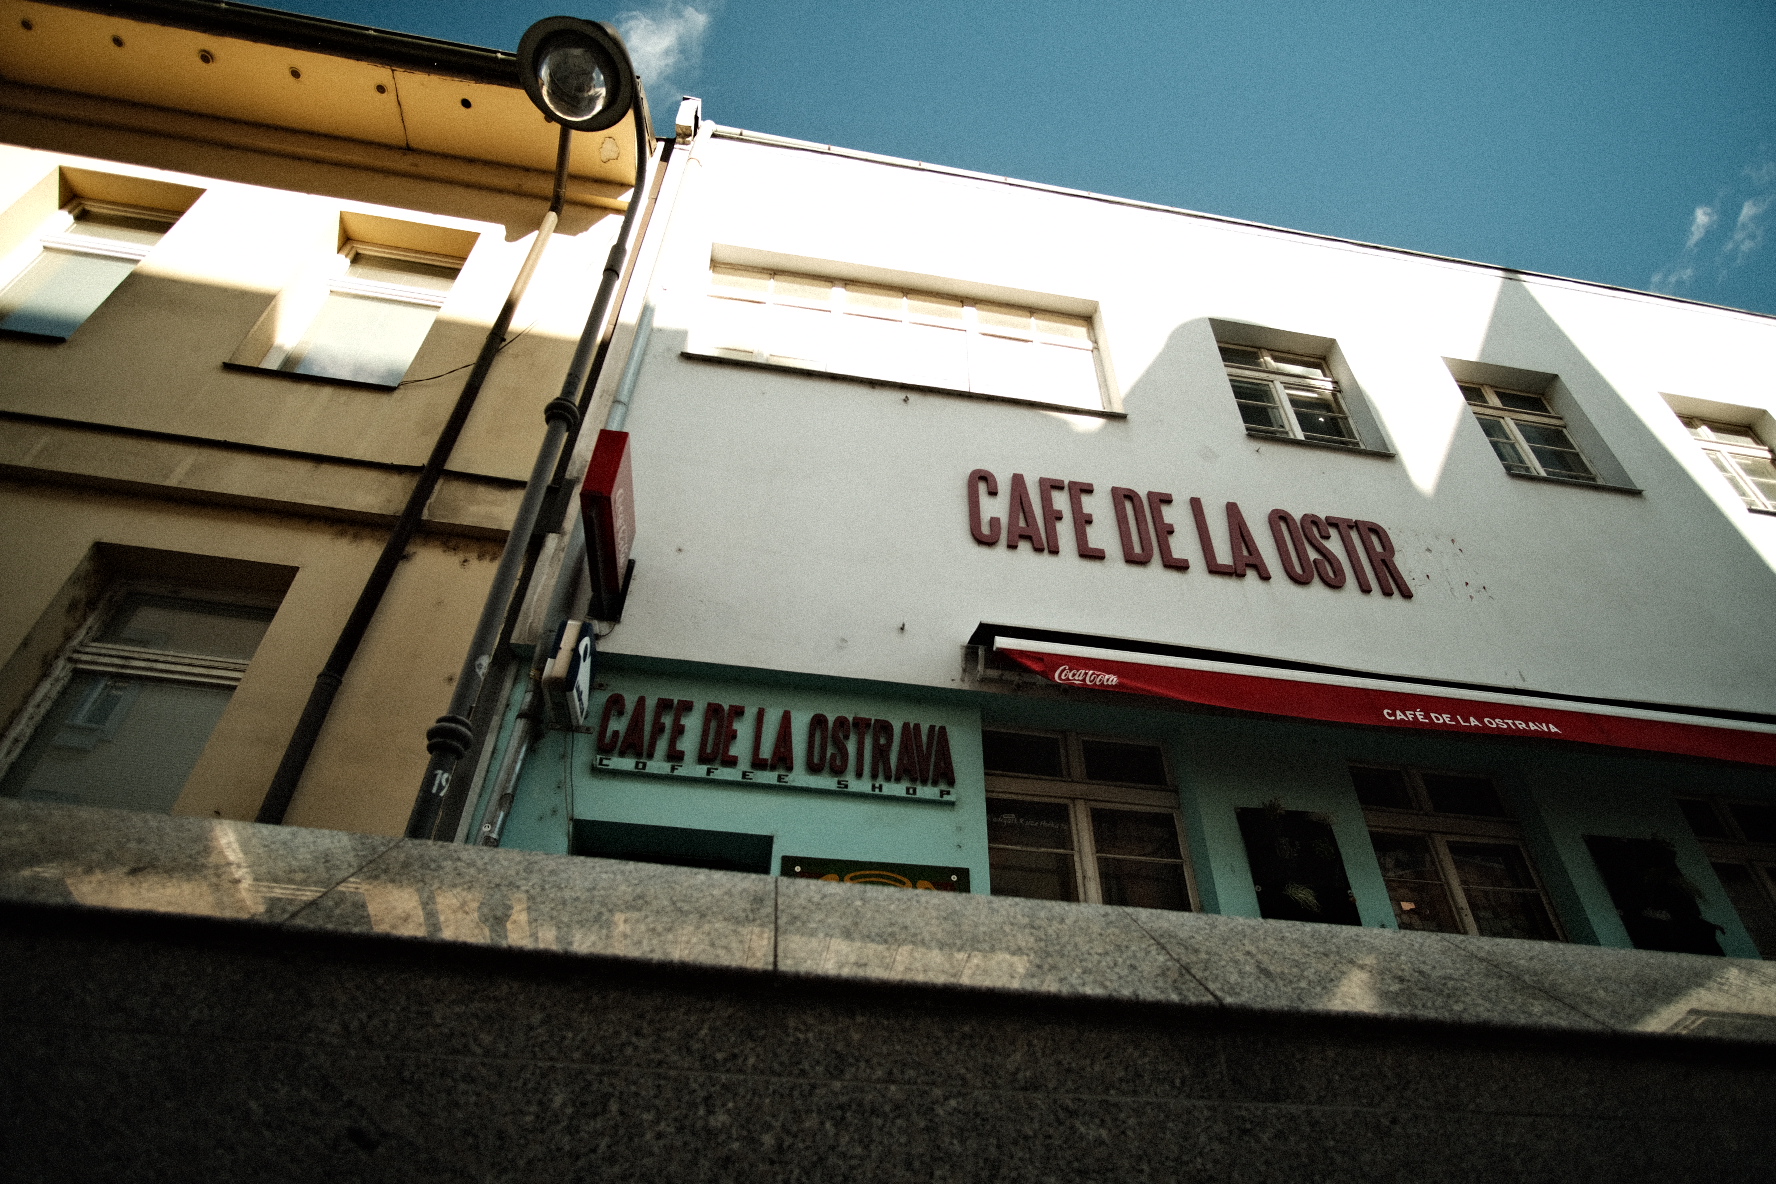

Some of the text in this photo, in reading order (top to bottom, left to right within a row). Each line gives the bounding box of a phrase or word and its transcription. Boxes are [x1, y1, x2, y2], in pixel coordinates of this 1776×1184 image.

[967, 468, 1414, 599] CAFE DE LA OSTR
[597, 692, 694, 761] CAFE
[698, 702, 745, 767] DE
[751, 707, 794, 771] LA
[806, 713, 956, 786] OSTRAVA
[1383, 708, 1562, 734] CAFÉ DE LA OSTRAVA
[598, 756, 952, 799] COFFEE SHOP
